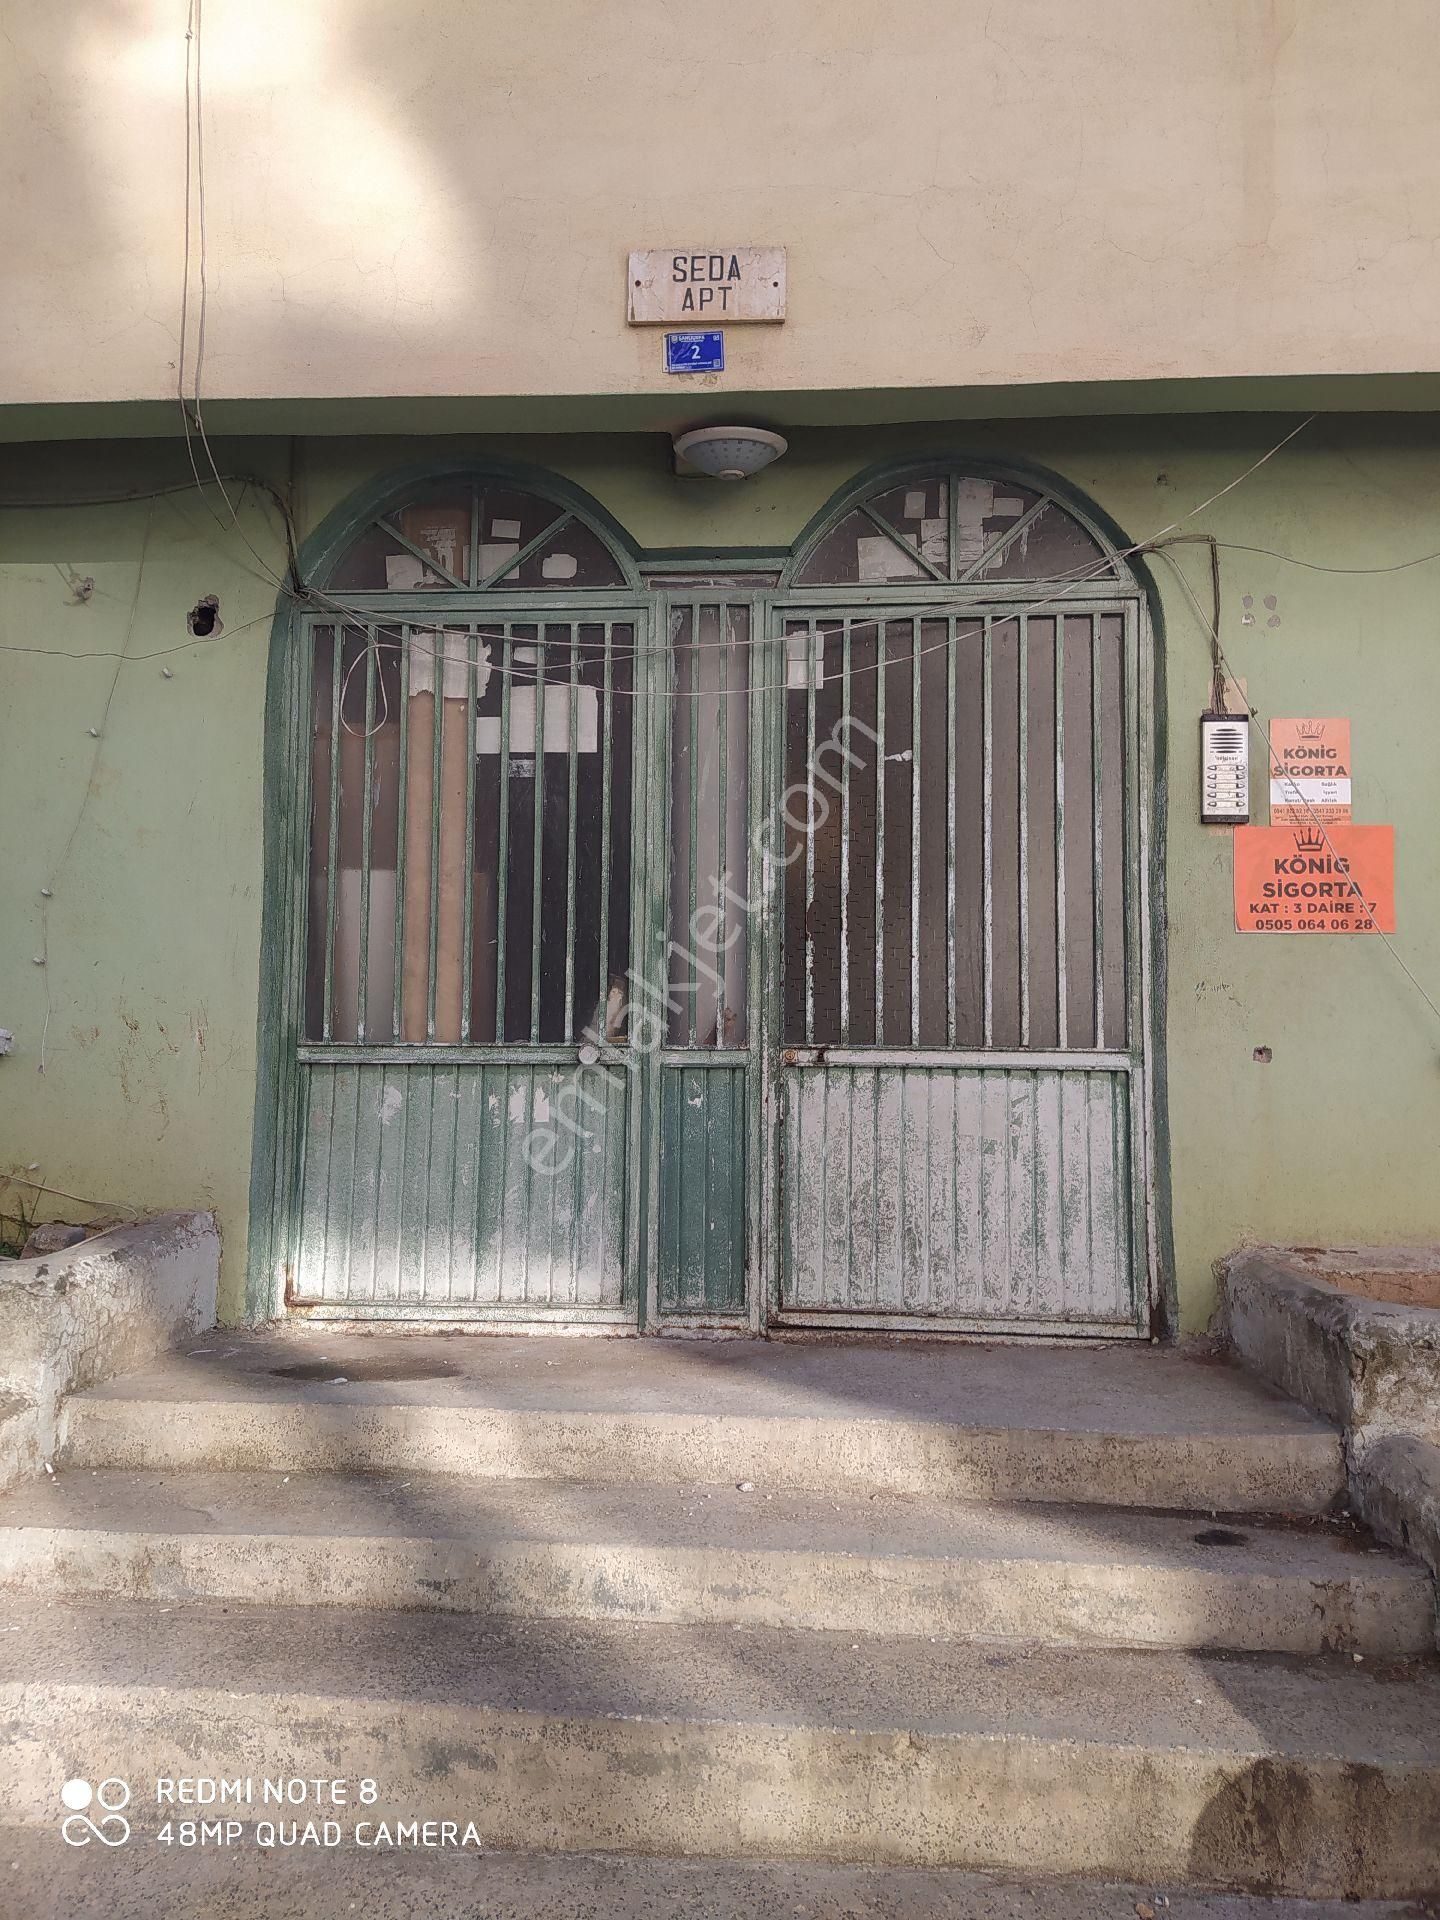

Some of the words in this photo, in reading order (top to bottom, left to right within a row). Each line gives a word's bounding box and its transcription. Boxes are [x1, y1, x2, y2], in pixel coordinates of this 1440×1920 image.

[672, 254, 741, 282] SEDA
[681, 286, 732, 311] APT
[690, 345, 701, 360] 2
[1283, 744, 1337, 759] KÖNİG
[1273, 762, 1347, 776] SİGORTA
[1274, 854, 1350, 874] KÖNİG
[1262, 879, 1363, 898] SİGORTA
[1250, 903, 1279, 913] KAT
[1293, 903, 1302, 913] 3
[1307, 900, 1355, 913] DAİRE
[1368, 902, 1377, 913] 7
[1255, 919, 1293, 930] 0505
[1298, 919, 1326, 930] 064
[1331, 919, 1349, 930] 06
[1355, 919, 1373, 930] 28
